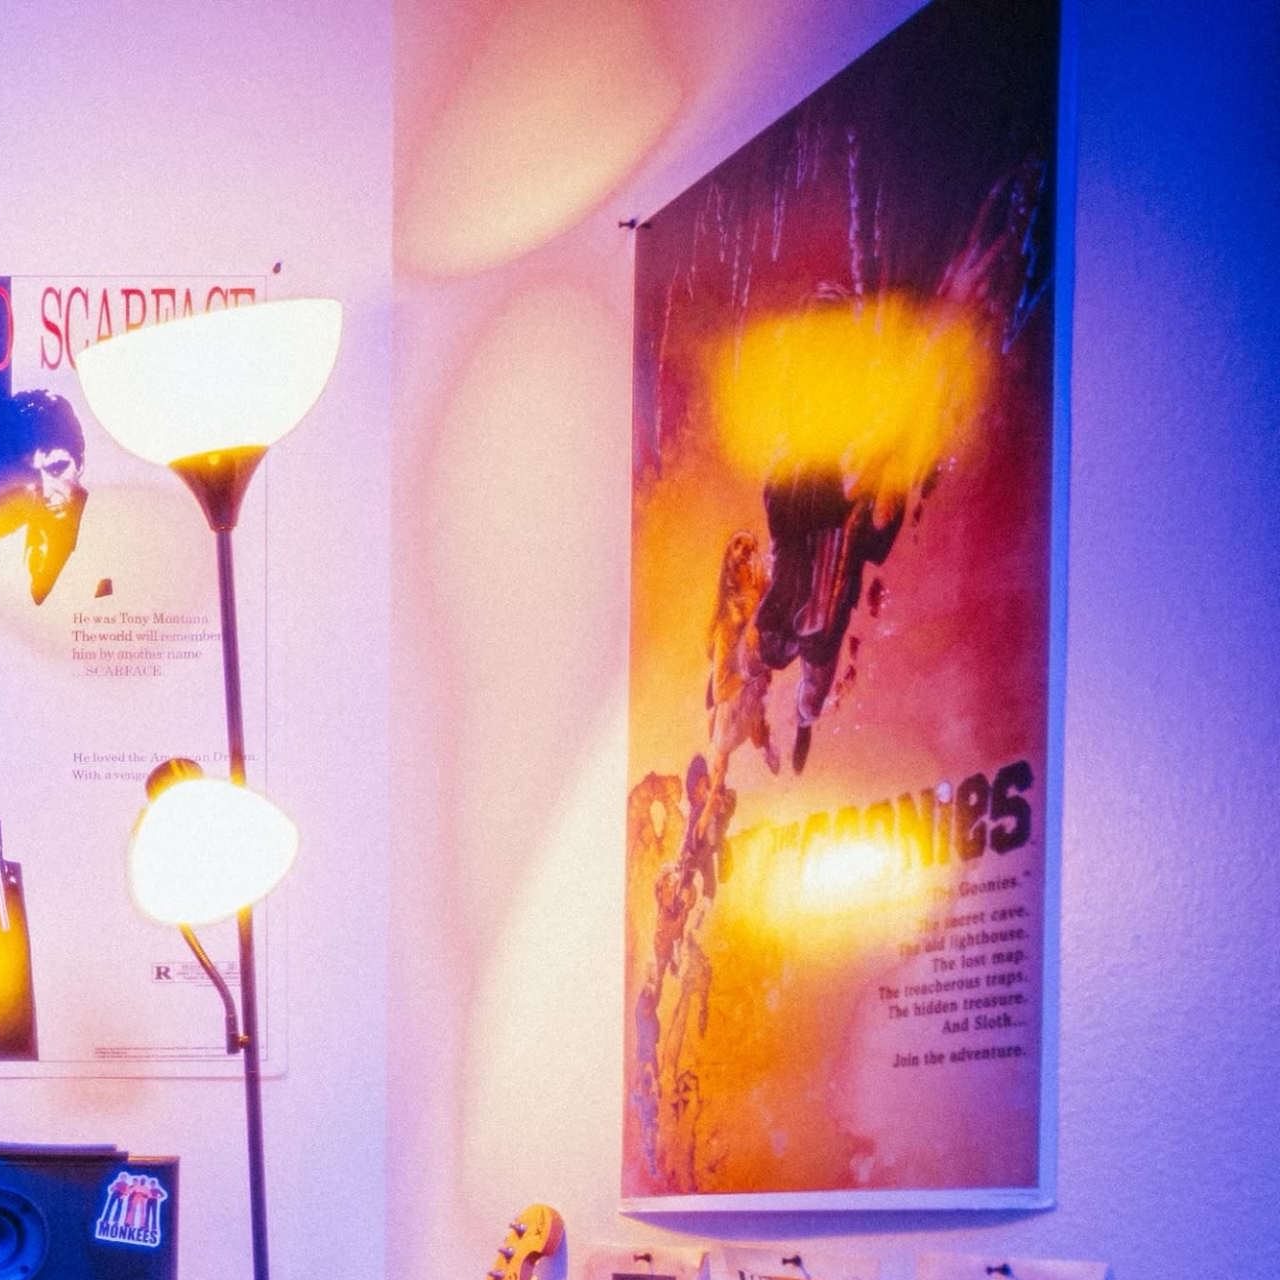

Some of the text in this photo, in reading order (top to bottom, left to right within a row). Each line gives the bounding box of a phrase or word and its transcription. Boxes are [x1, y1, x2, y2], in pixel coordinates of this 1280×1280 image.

[932, 957, 956, 973] The
[961, 953, 987, 969] lost
[942, 1018, 970, 1035] And
[892, 1045, 1027, 1068] Join the adventure.
[97, 1220, 159, 1245] MONKEES
